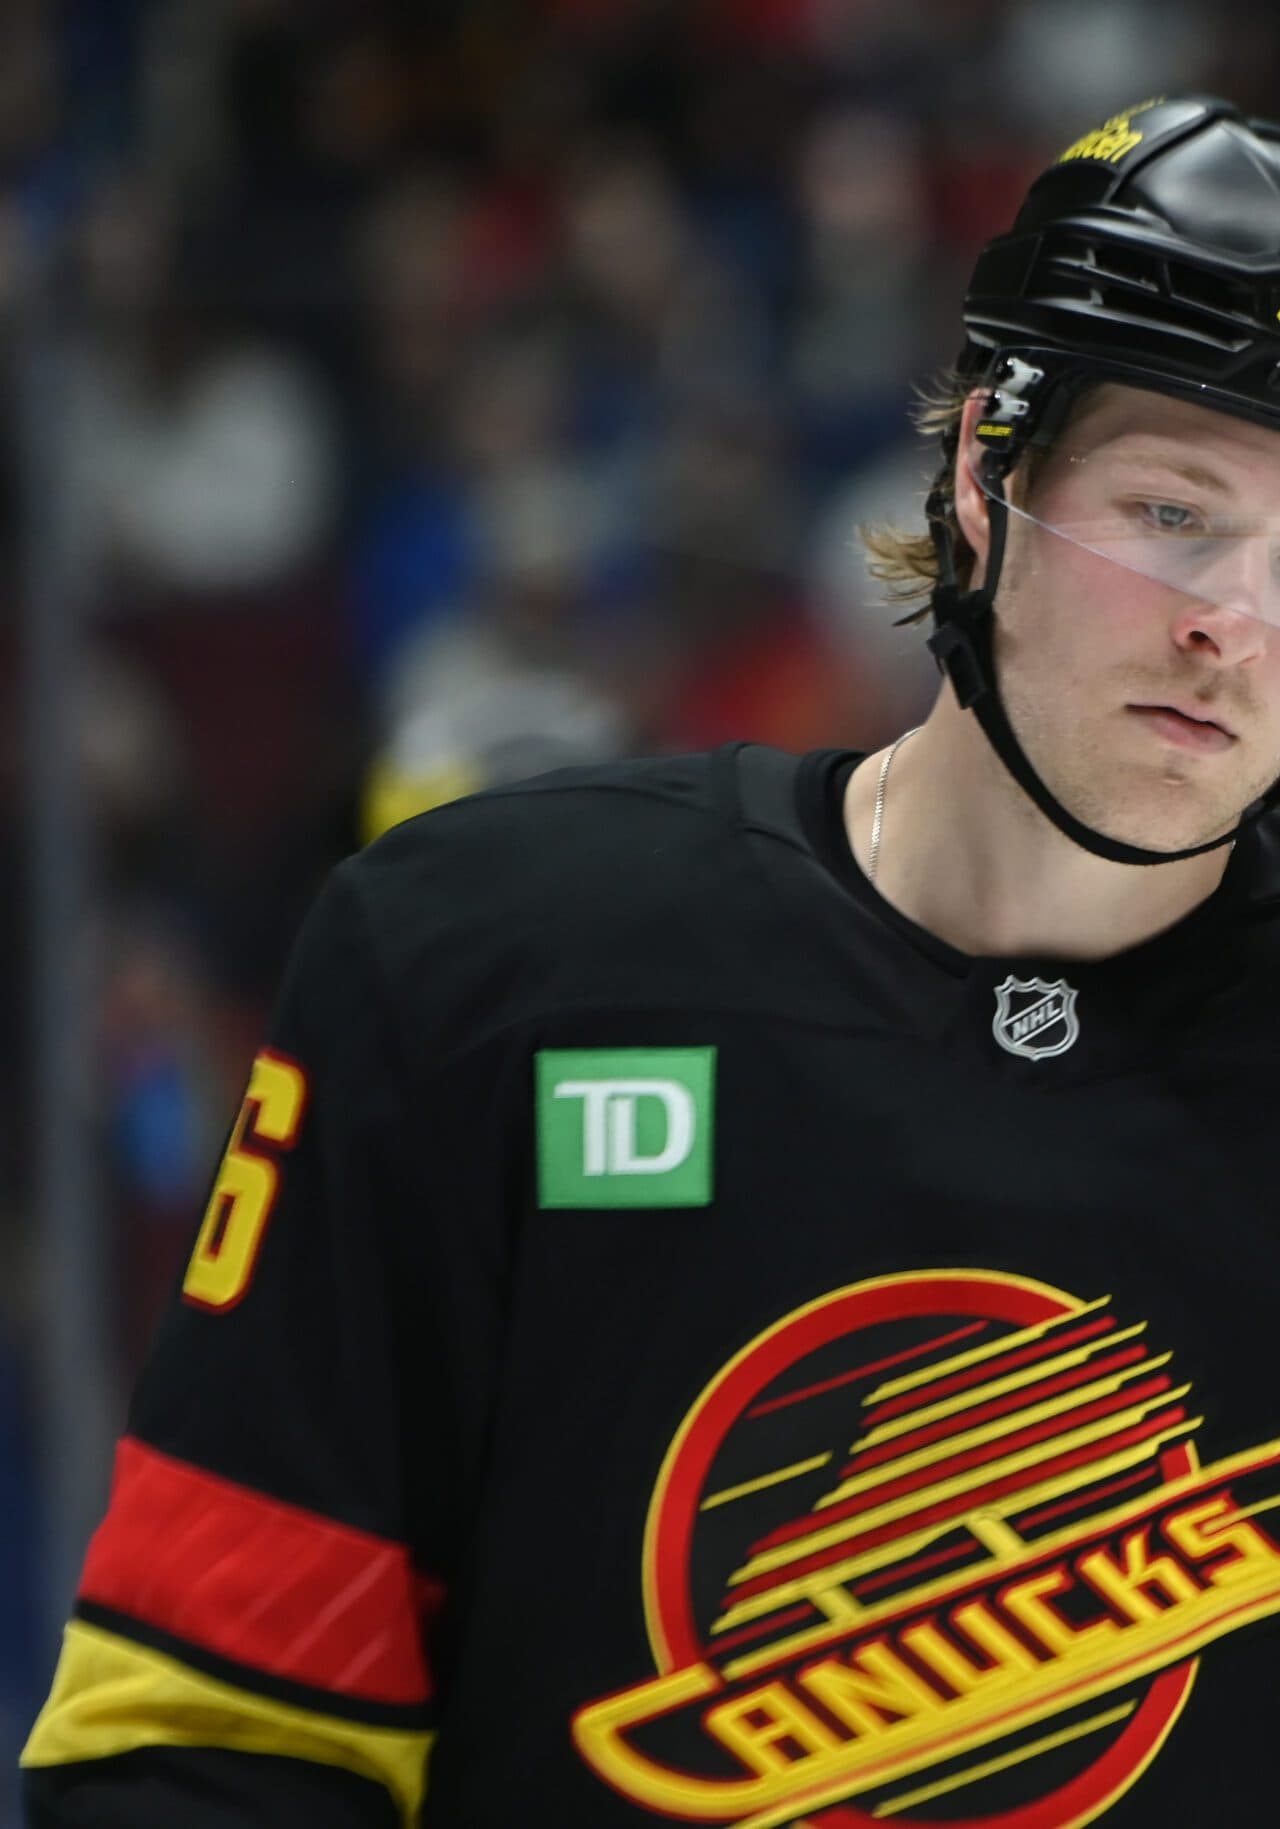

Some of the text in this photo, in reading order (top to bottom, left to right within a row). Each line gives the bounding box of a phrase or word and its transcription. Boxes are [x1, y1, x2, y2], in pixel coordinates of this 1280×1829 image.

[1012, 1000, 1062, 1041] NHL
[553, 1080, 697, 1177] TD
[181, 1045, 309, 1315] 6
